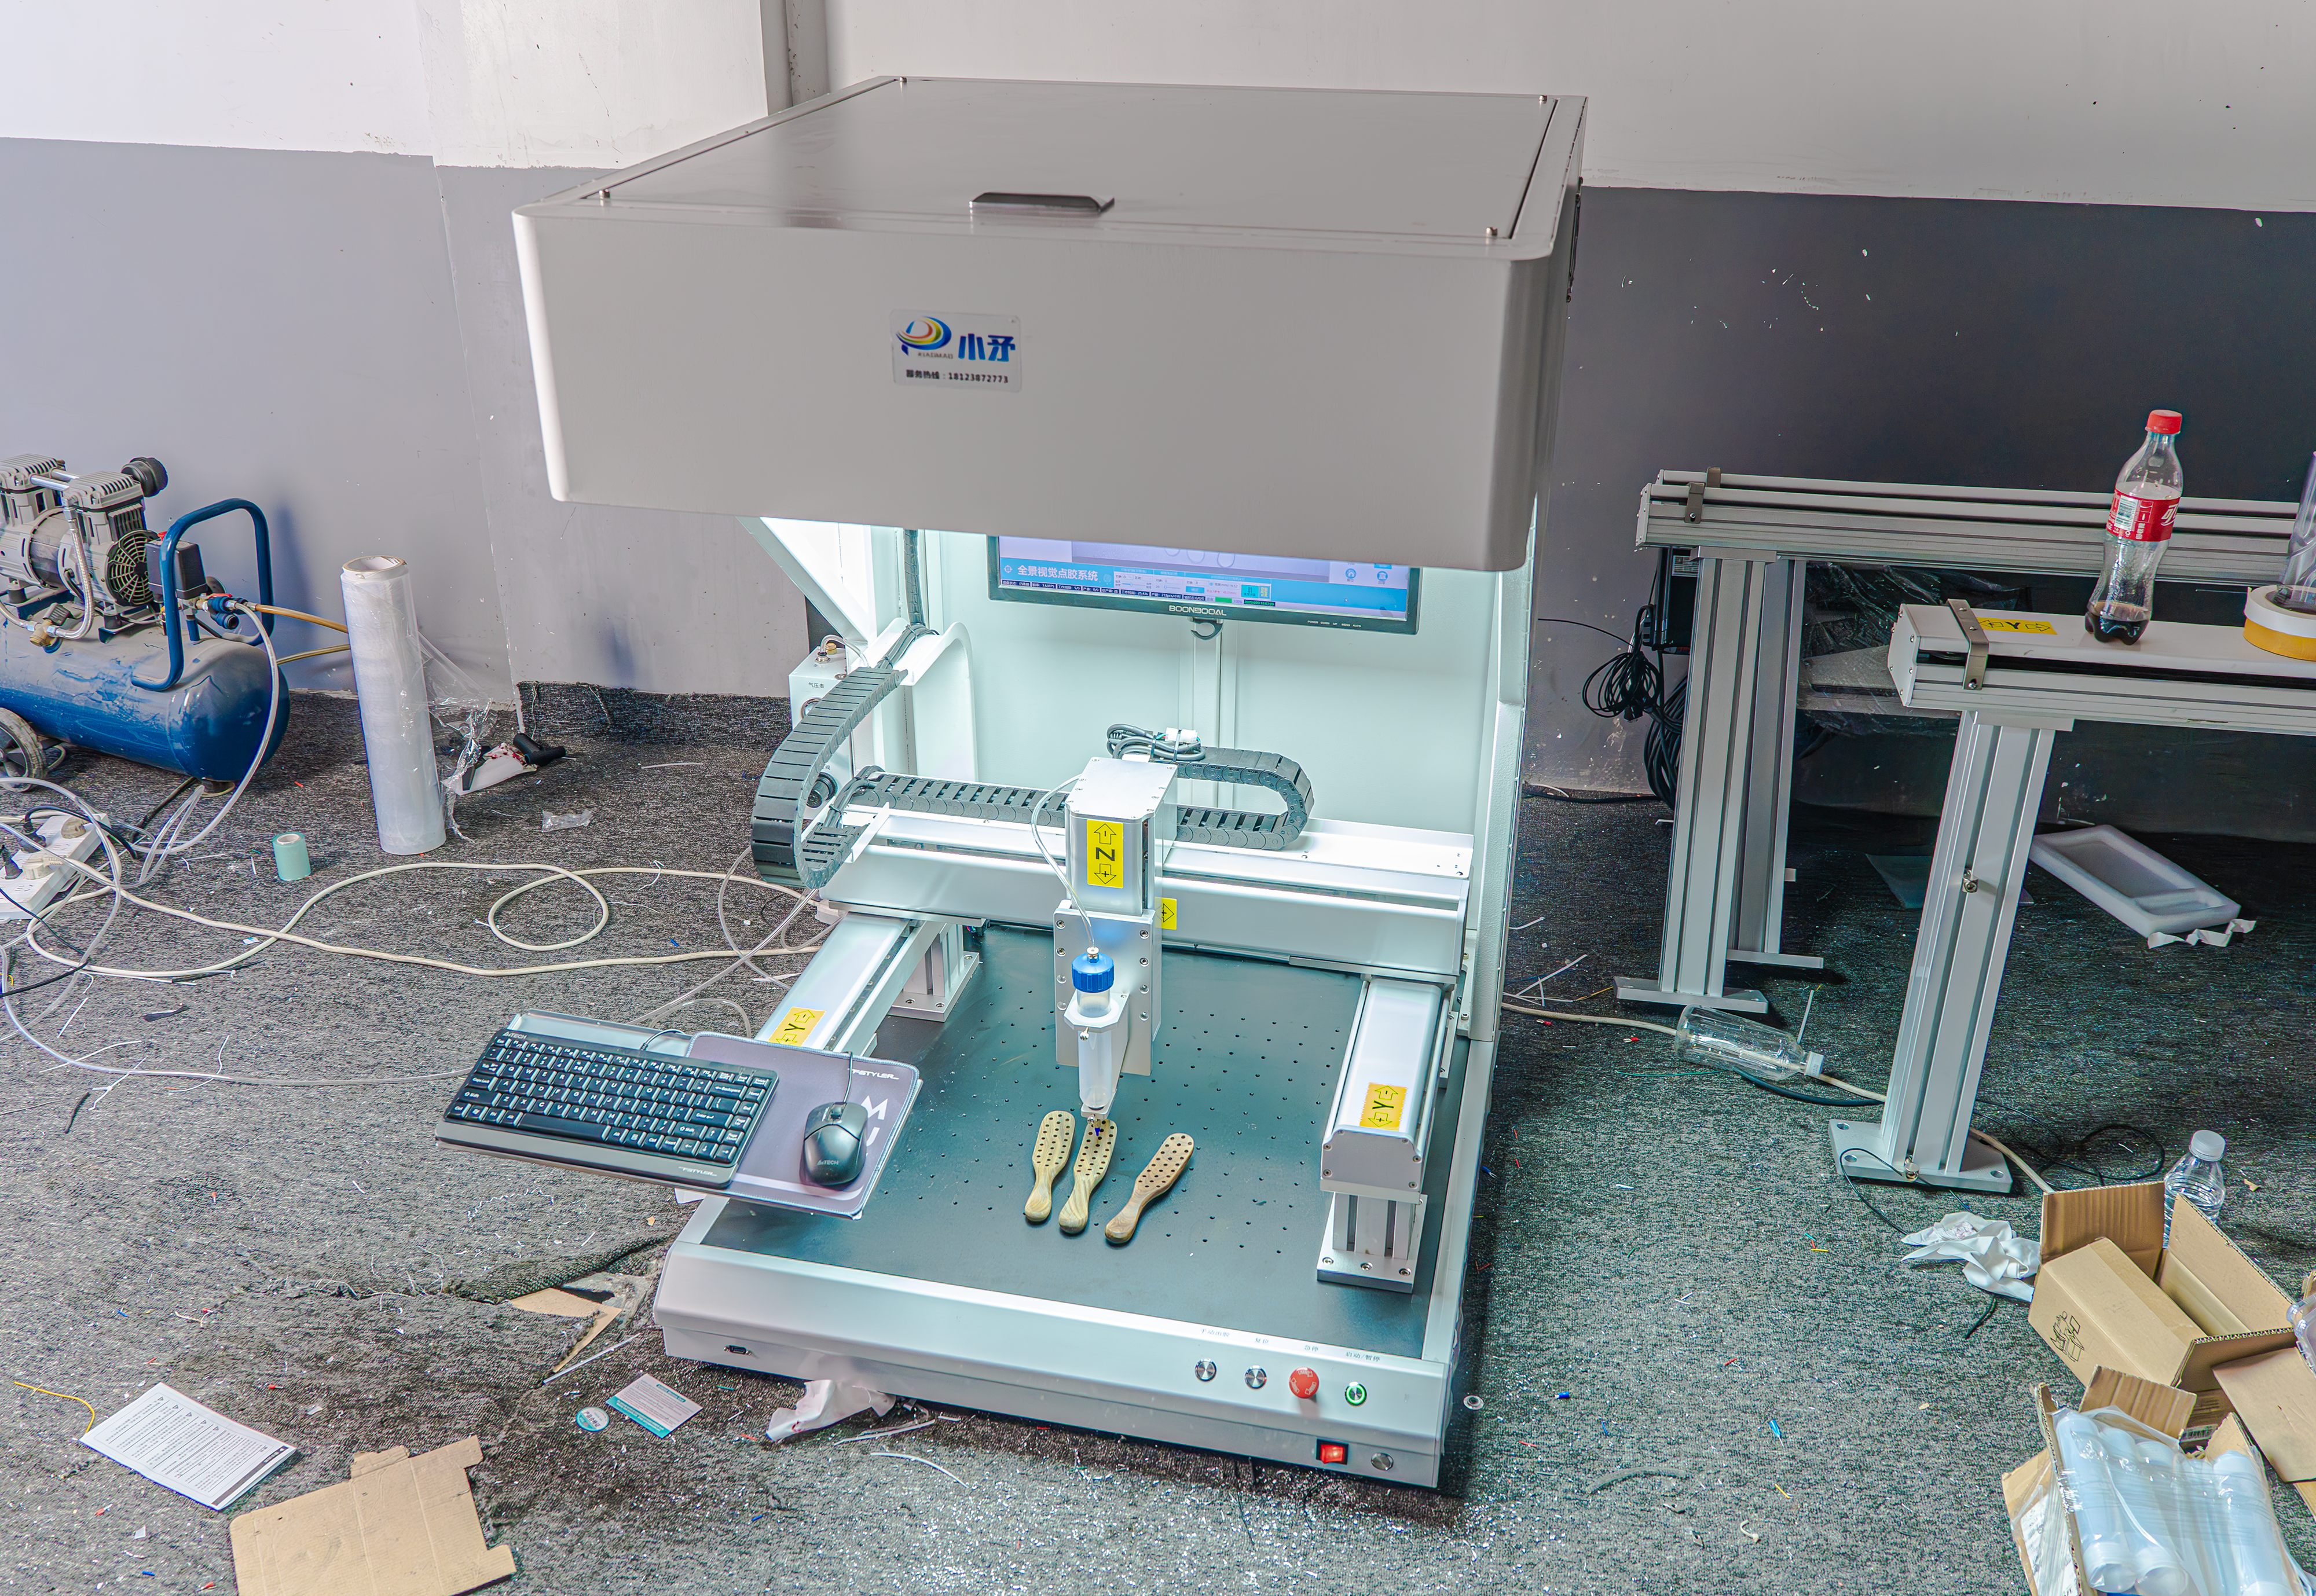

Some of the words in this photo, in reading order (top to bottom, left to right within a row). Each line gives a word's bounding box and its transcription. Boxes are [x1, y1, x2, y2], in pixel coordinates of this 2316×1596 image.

[1018, 565, 1098, 581] 全景视觉点胶系统
[2004, 621, 2021, 629] Y
[784, 1022, 806, 1032] Y
[1372, 1100, 1394, 1109] Y
